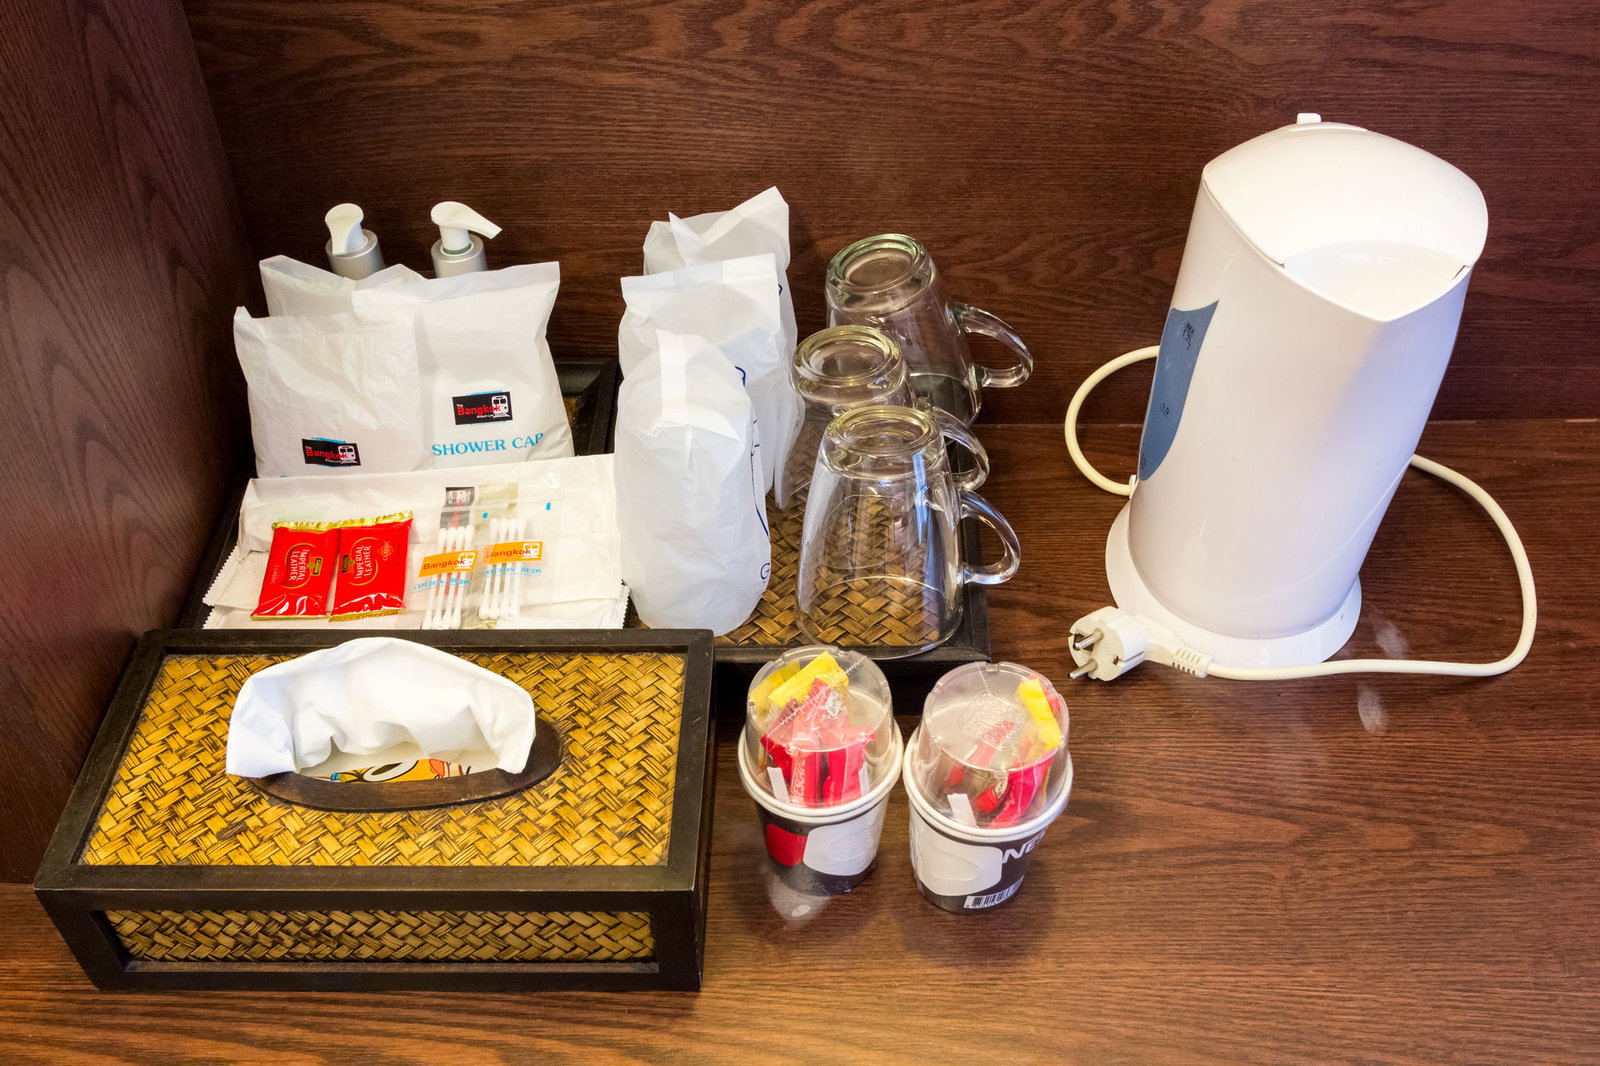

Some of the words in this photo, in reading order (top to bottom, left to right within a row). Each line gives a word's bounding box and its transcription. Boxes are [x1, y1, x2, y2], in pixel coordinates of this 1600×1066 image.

[457, 404, 502, 416] Bangkok
[305, 448, 349, 460] Bangkok
[431, 439, 507, 456] SHOWER
[511, 432, 545, 449] CAP
[289, 550, 300, 582] LEATHER
[297, 549, 310, 580] IMPERIAL
[354, 545, 365, 579] IMPERIAL
[363, 545, 372, 577] LEATHER
[423, 558, 465, 570] Bangkok
